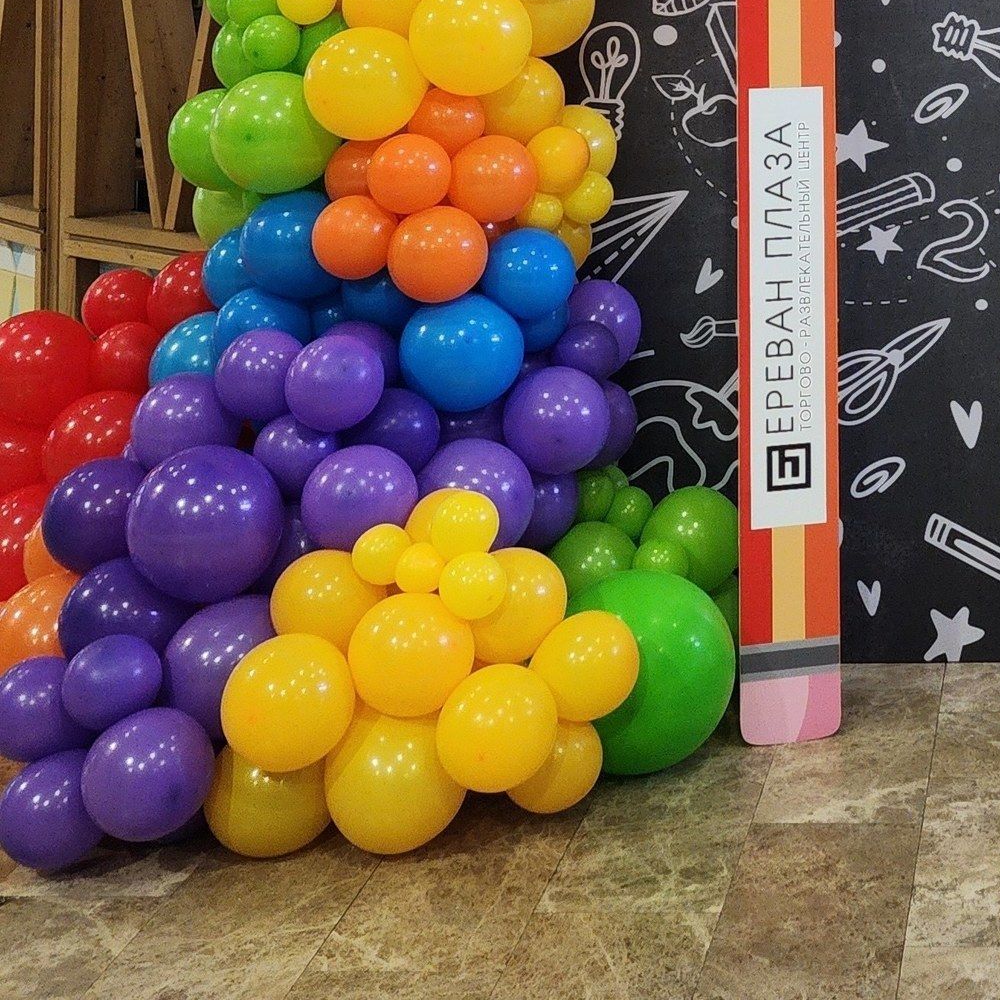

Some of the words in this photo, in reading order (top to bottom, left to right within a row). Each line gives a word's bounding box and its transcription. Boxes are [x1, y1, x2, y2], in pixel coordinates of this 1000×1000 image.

[764, 122, 793, 258] ПЛАЗА
[798, 122, 811, 170] ЦЕНТР
[916, 199, 989, 283] 2
[765, 280, 794, 434] ЕРЕВАН
